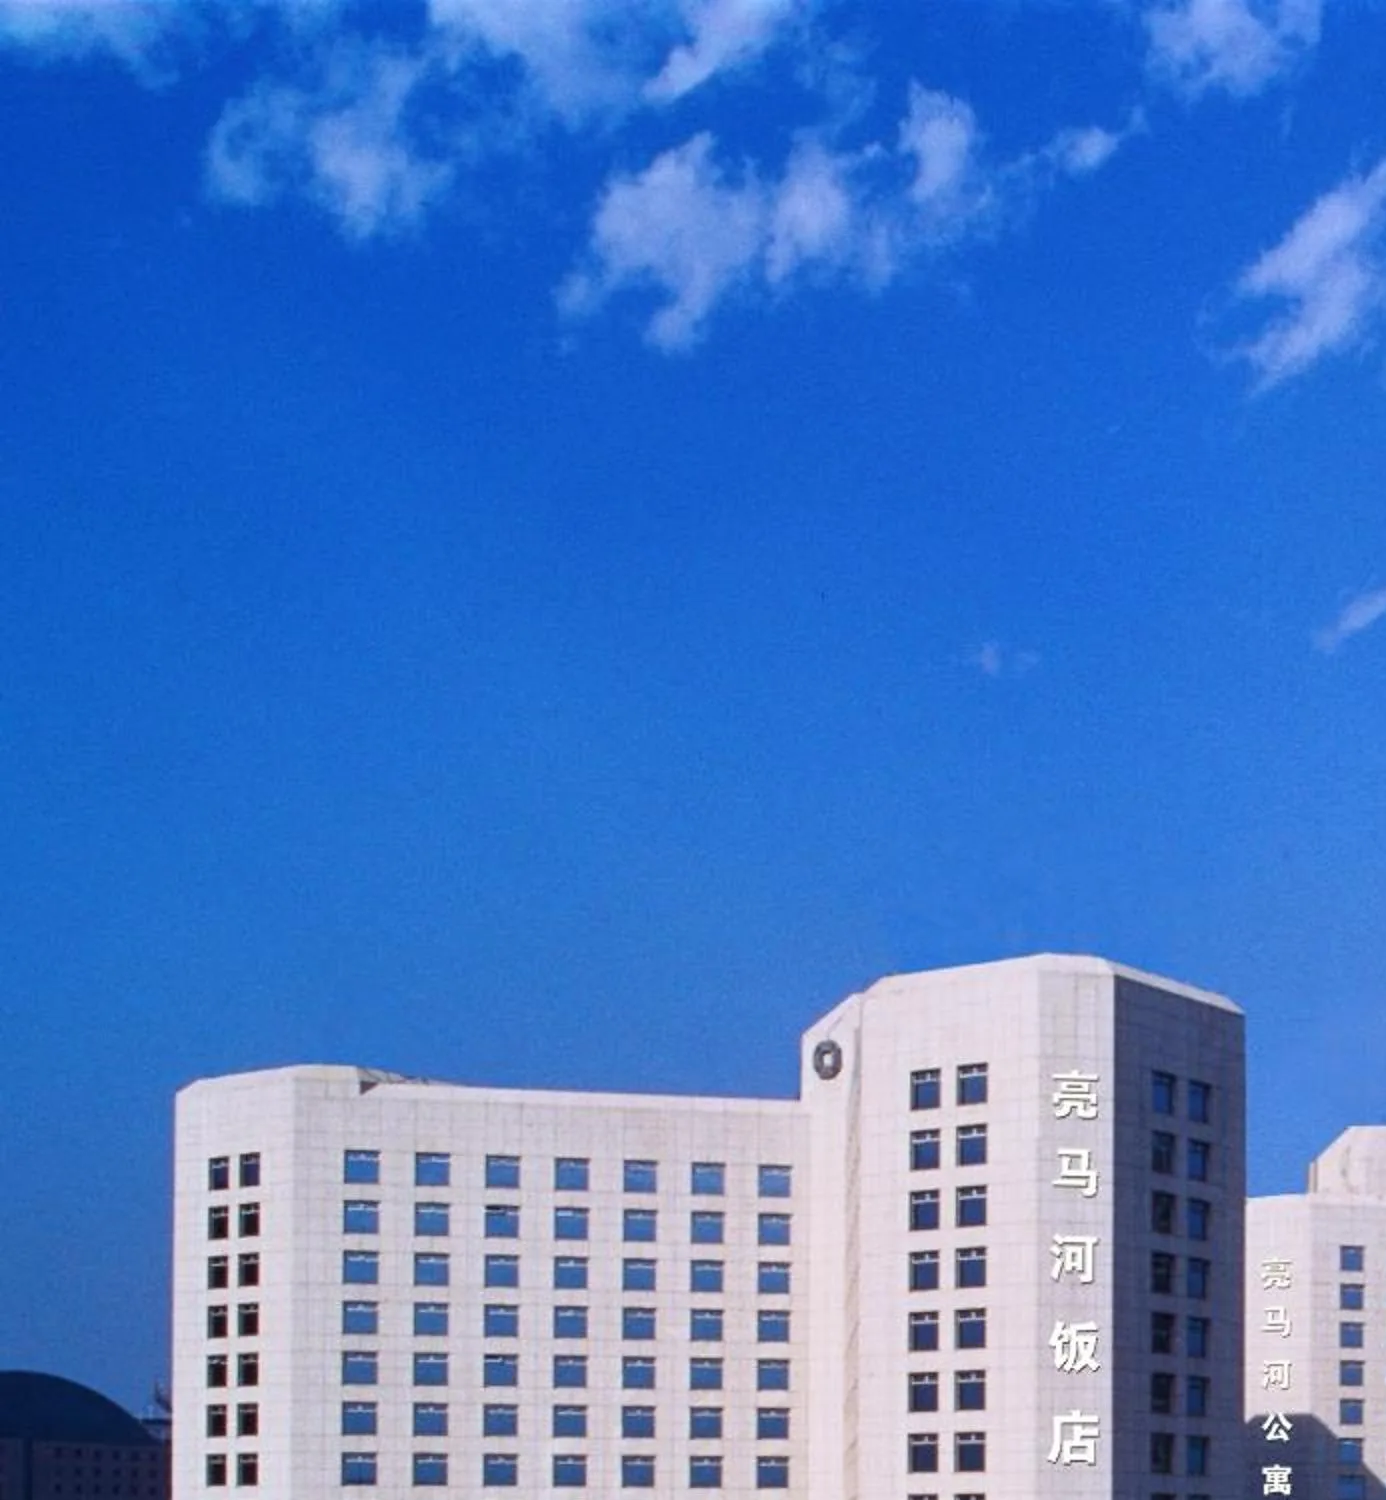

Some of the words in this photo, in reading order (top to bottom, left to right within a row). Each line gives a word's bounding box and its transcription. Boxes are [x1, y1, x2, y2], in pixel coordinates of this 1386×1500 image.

[1048, 1069, 1100, 1467] 亮马河饭店
[1261, 1258, 1293, 1496] 亮马河公寓
